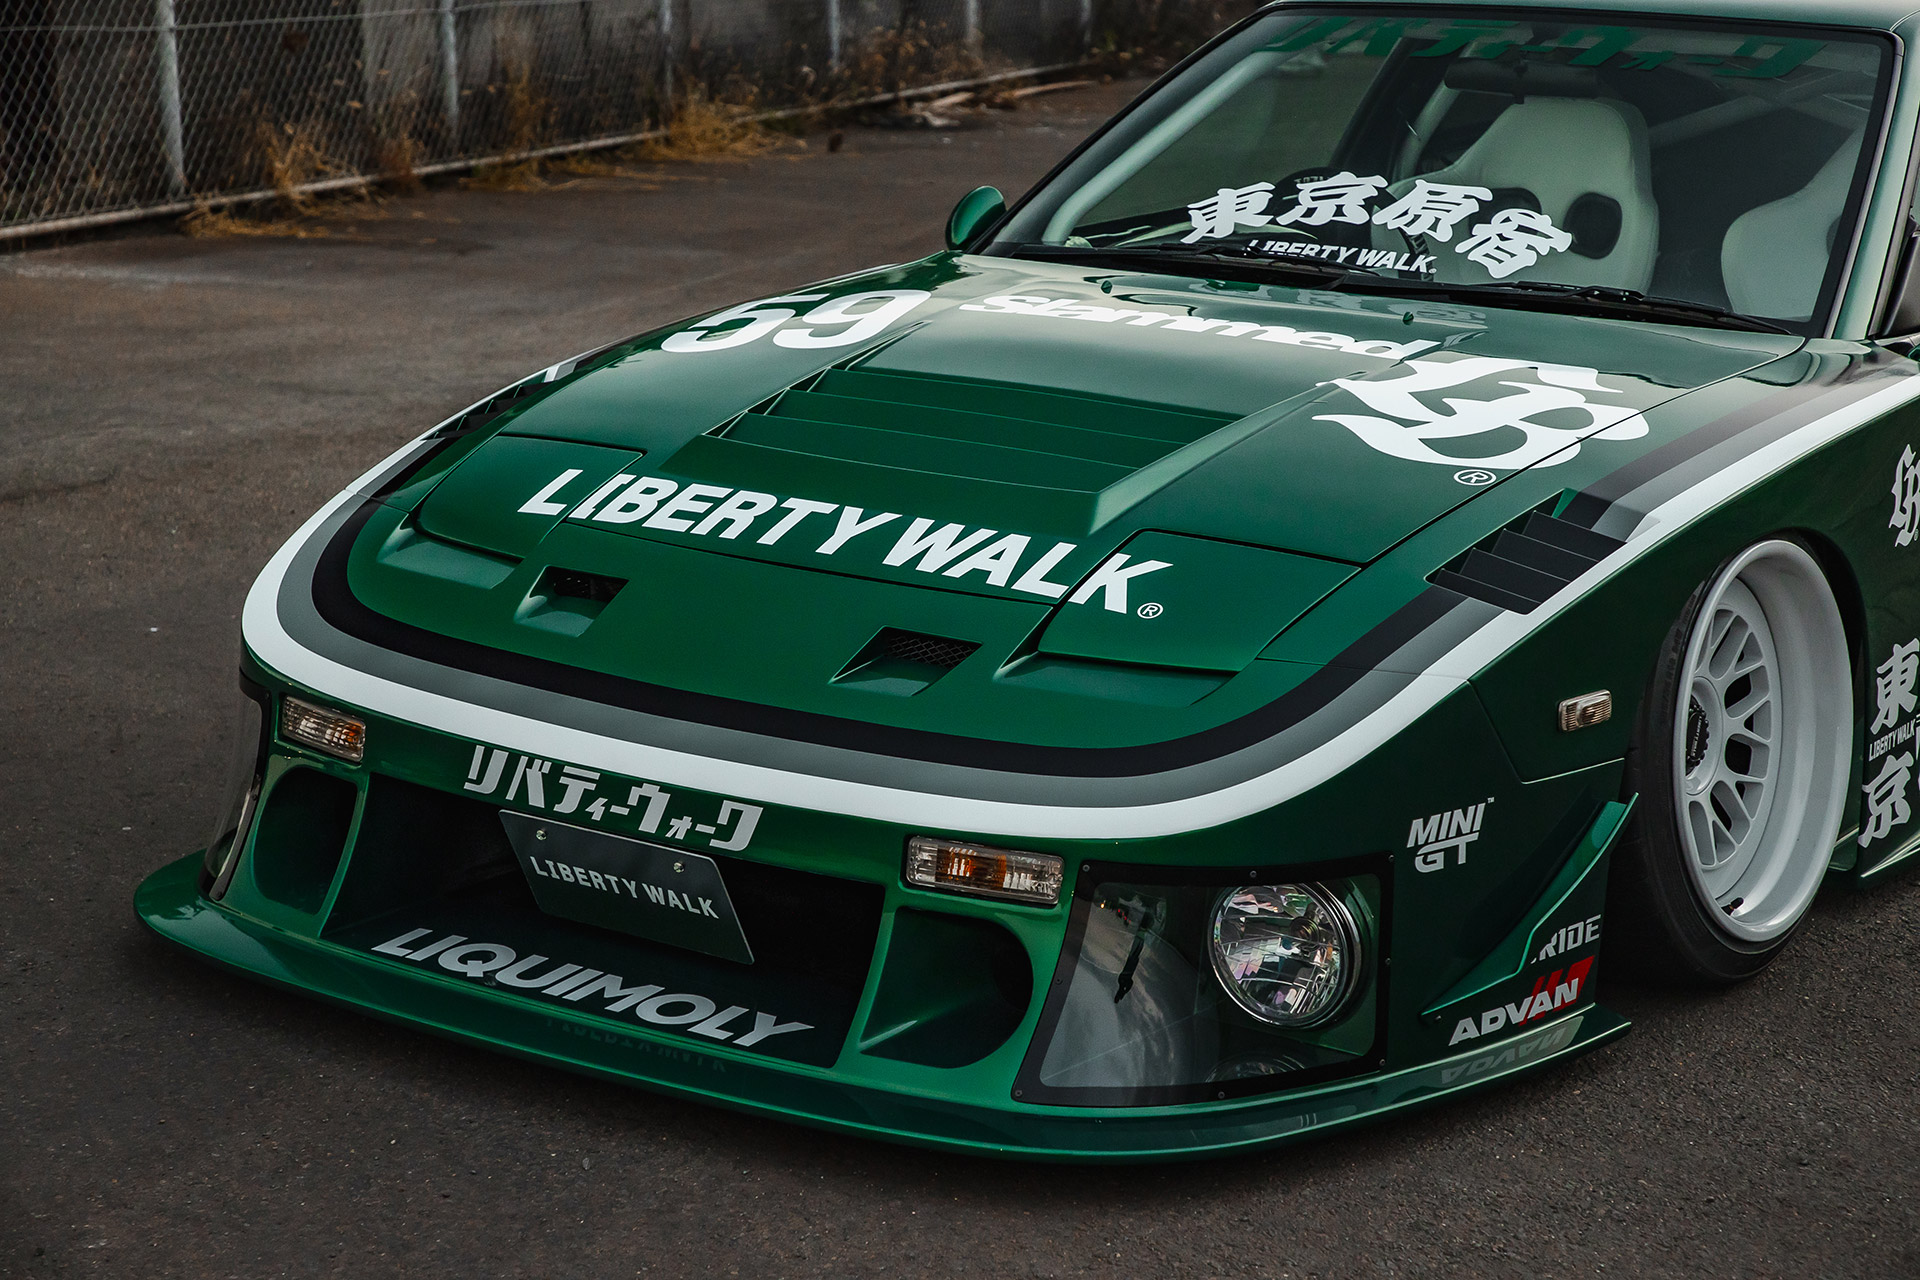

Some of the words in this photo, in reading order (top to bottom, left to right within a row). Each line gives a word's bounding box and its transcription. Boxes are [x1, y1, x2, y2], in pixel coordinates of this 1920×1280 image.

[661, 289, 932, 352] 59
[959, 295, 1442, 360] Slammed
[518, 469, 902, 554] LIBERTY
[1868, 730, 1898, 762] LIBERTY
[463, 745, 764, 852] リバティーウォーク
[1414, 832, 1480, 873] GT
[530, 856, 639, 899] LIBERTY
[641, 883, 719, 919] WALK
[1531, 914, 1602, 964] RIDE
[1448, 977, 1579, 1046] ADVAN
